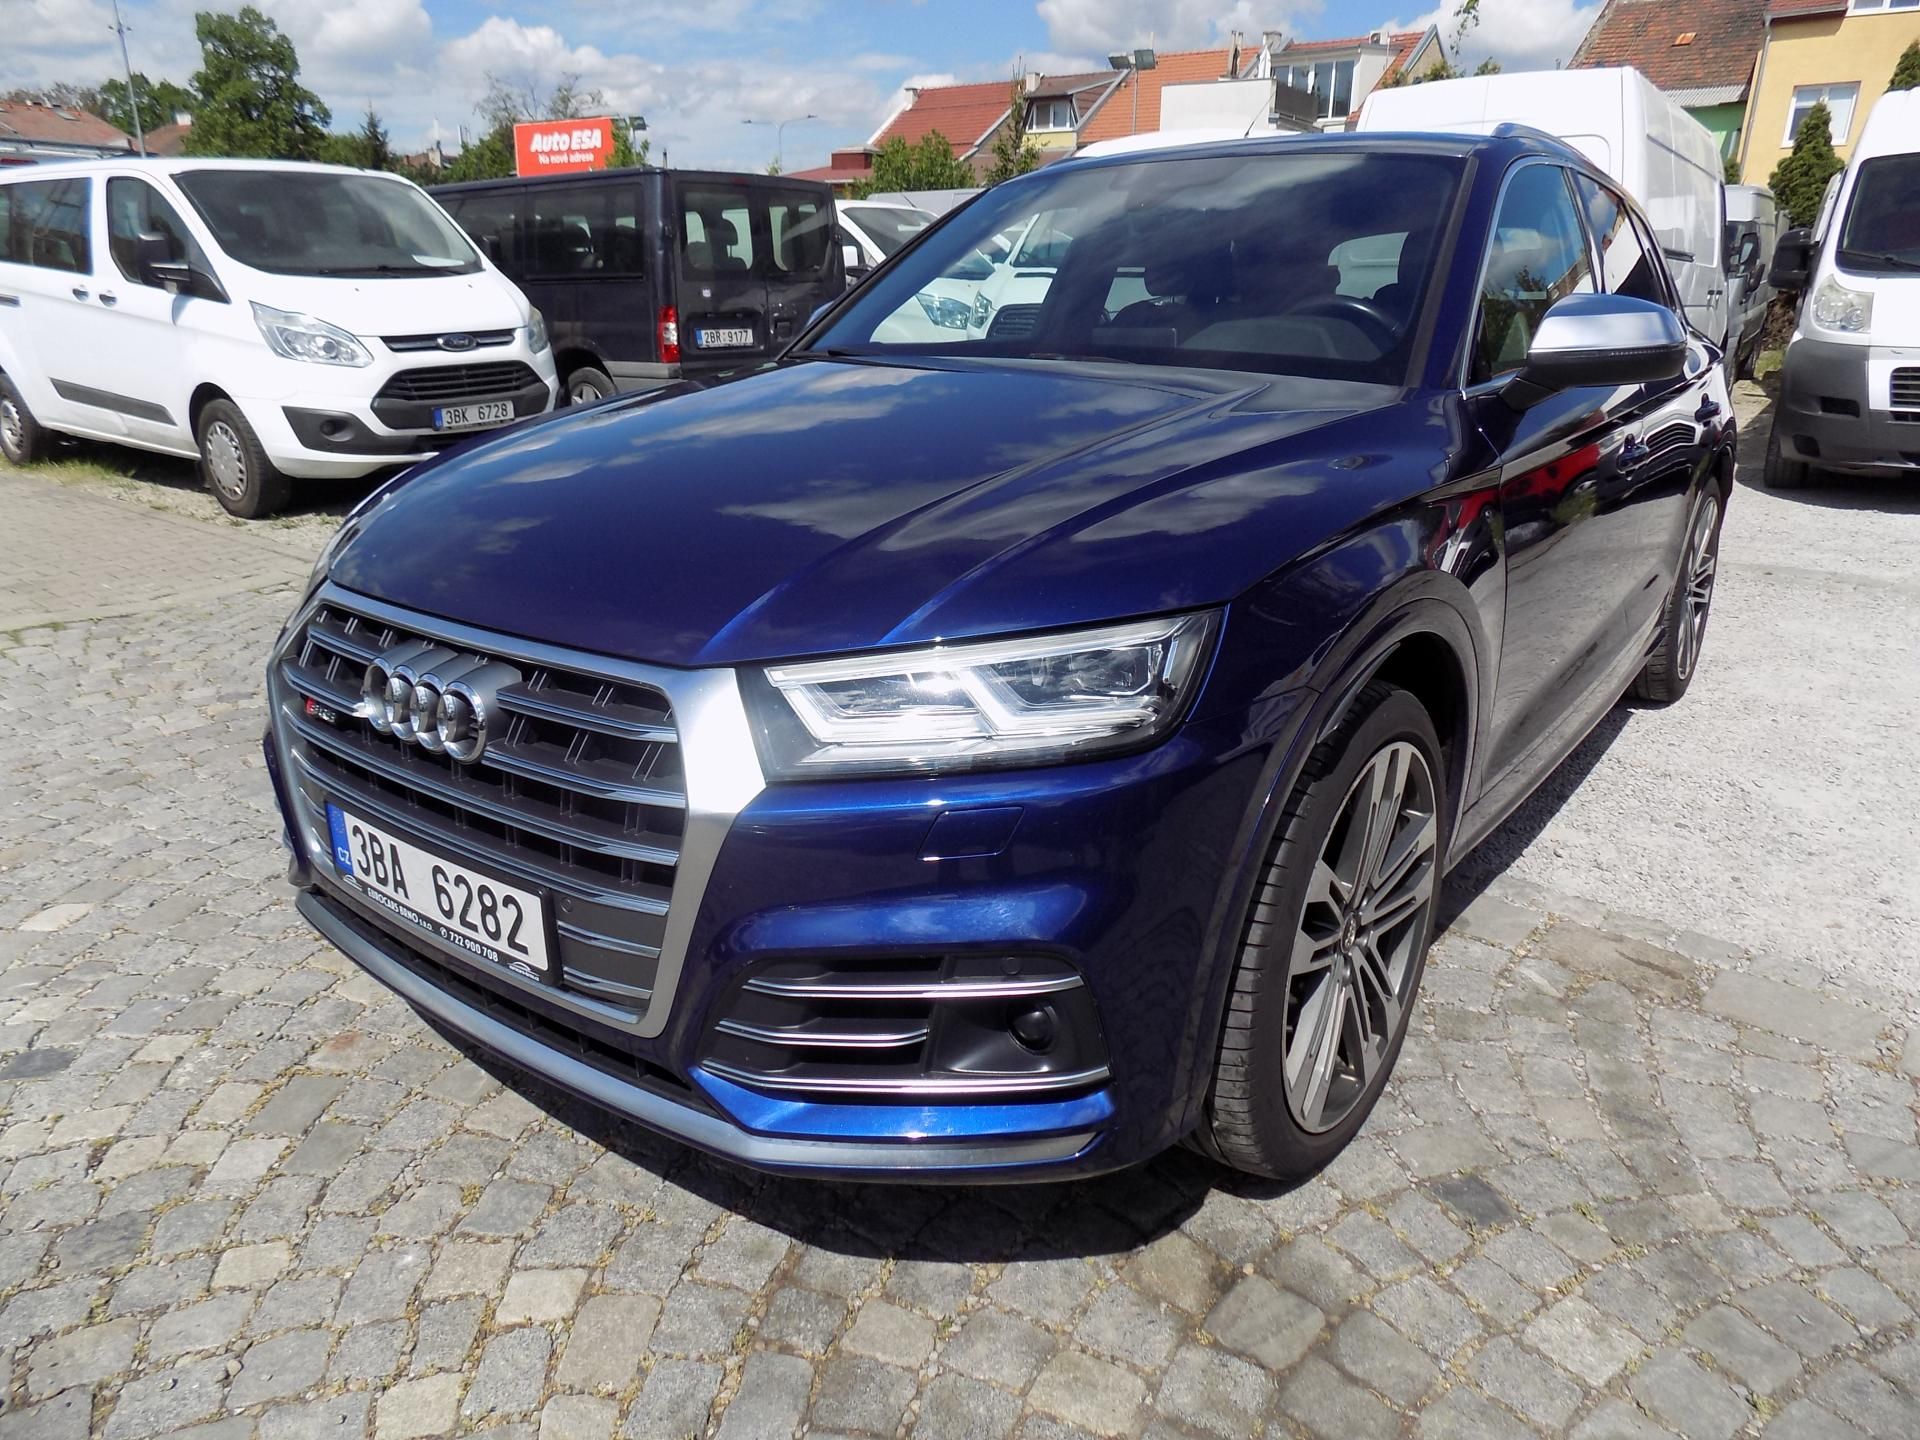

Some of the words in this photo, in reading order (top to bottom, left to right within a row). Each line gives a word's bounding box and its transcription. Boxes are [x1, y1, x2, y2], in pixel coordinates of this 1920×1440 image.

[530, 132, 570, 153] Auto
[571, 128, 602, 150] ESA
[538, 154, 550, 165] Na
[569, 152, 594, 163] adrese
[704, 331, 722, 344] 2BR
[727, 330, 748, 342] 9177
[446, 408, 469, 424] 3BK
[478, 403, 508, 420] 6728
[338, 847, 351, 865] CZ
[352, 824, 410, 900] 3BA
[431, 864, 529, 955] 6282
[367, 887, 399, 912] EUROCARS
[399, 905, 419, 923] BRNO
[449, 931, 465, 946] 722
[465, 938, 481, 955] 900
[482, 946, 499, 962] 708
